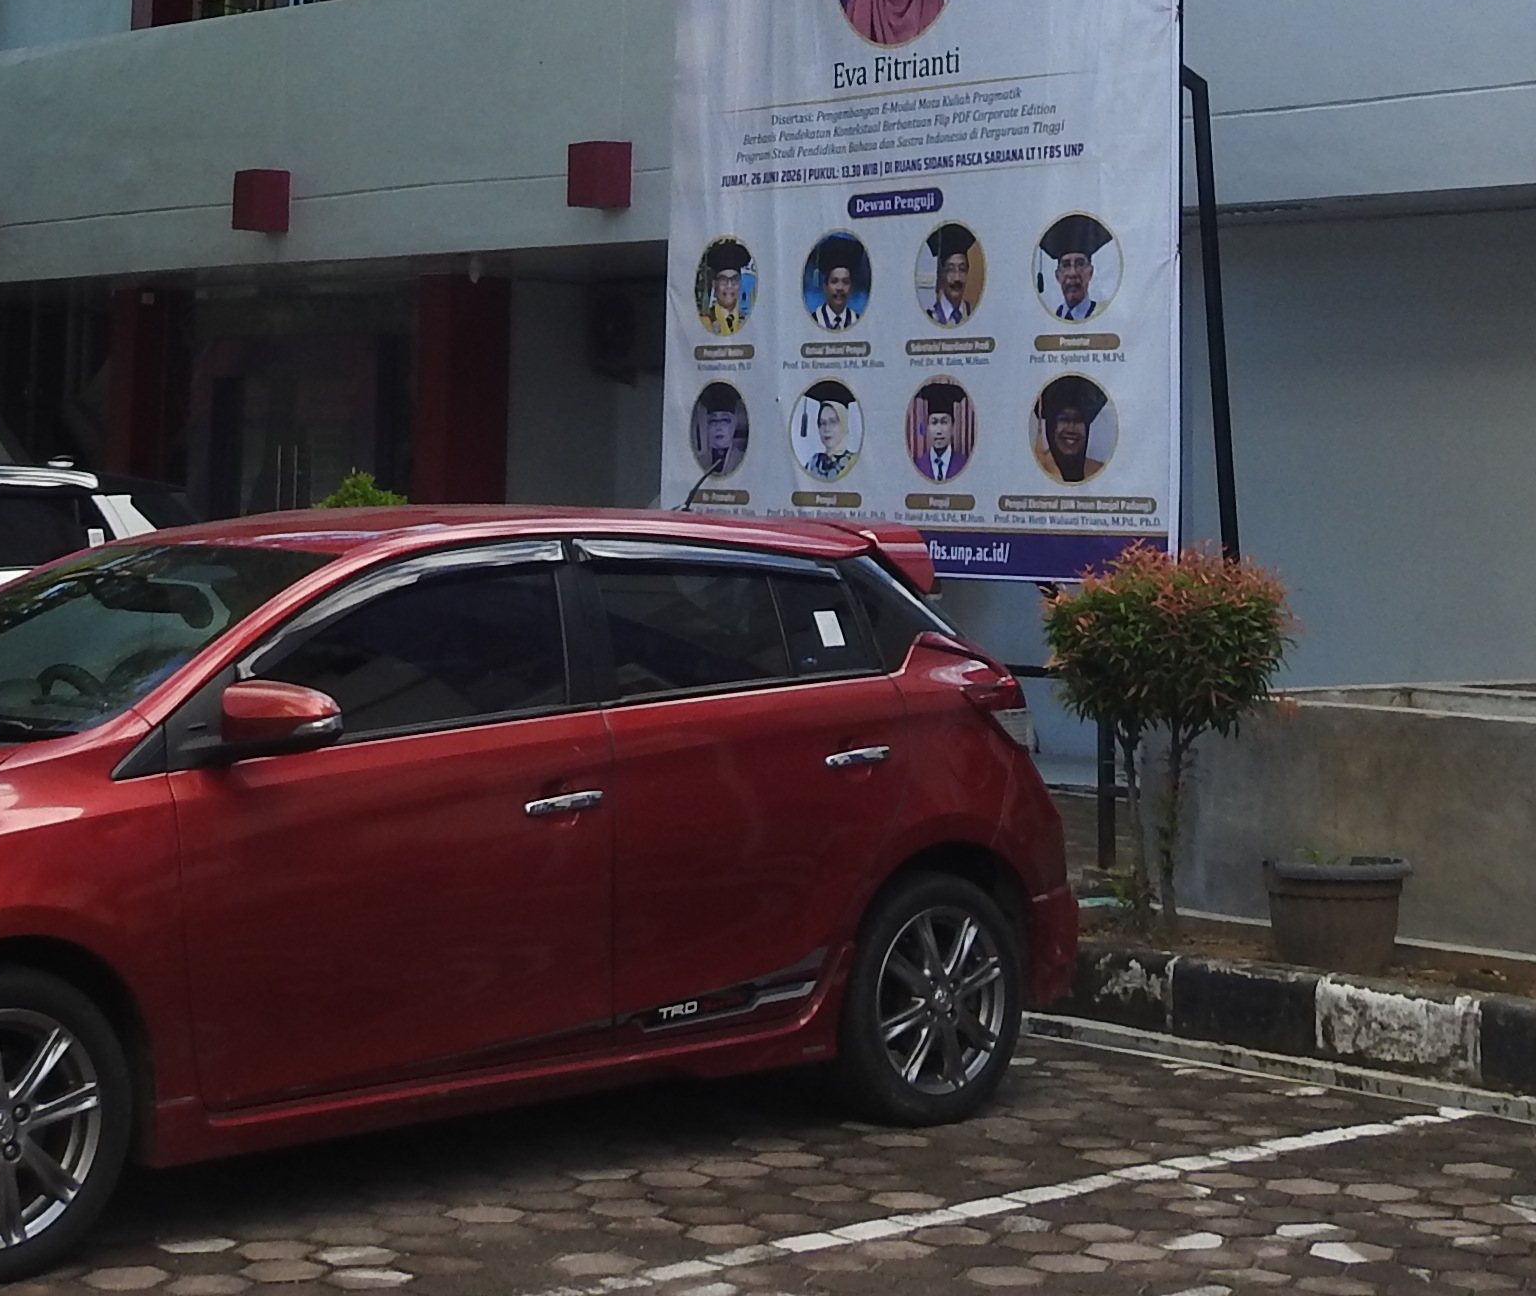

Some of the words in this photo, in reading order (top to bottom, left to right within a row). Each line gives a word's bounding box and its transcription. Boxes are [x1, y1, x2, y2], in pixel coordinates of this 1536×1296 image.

[834, 62, 867, 88] Eva
[874, 46, 960, 83] Fitrianti
[771, 110, 814, 126] Disertasi:
[918, 97, 940, 110] Mata
[972, 87, 1022, 106] Pragmatik
[779, 127, 831, 142] Pendekatan
[833, 122, 881, 137] Kontekstual
[882, 116, 932, 133] Berbantuan
[934, 113, 950, 128] Flip
[952, 109, 972, 124] PDF
[972, 106, 1019, 124] Corporate
[1021, 103, 1056, 117] Edition
[736, 150, 771, 165] Program
[797, 142, 847, 158] Pendidikan
[879, 136, 895, 149] dan
[896, 133, 924, 147] Sastra
[926, 129, 967, 146] Indonesia
[969, 127, 979, 140] di
[980, 123, 1029, 141] Perguruan
[721, 172, 749, 188] JUMAT,
[781, 169, 802, 183] 2026
[808, 167, 839, 181] PUKUL:
[862, 162, 878, 176] WIB
[885, 161, 893, 174] DI
[894, 158, 922, 173] RUANG
[923, 155, 954, 170] SIDANG
[956, 152, 982, 168] PASCA
[984, 148, 1024, 165] SARJANA
[1026, 147, 1037, 161] LT
[1043, 145, 1062, 159] FBS
[1063, 143, 1084, 158] UNP
[856, 197, 891, 213] Dewan
[894, 192, 935, 212] Penguji
[929, 540, 1010, 565] fbs.unp.ac.id/
[658, 1001, 698, 1020] TRD
